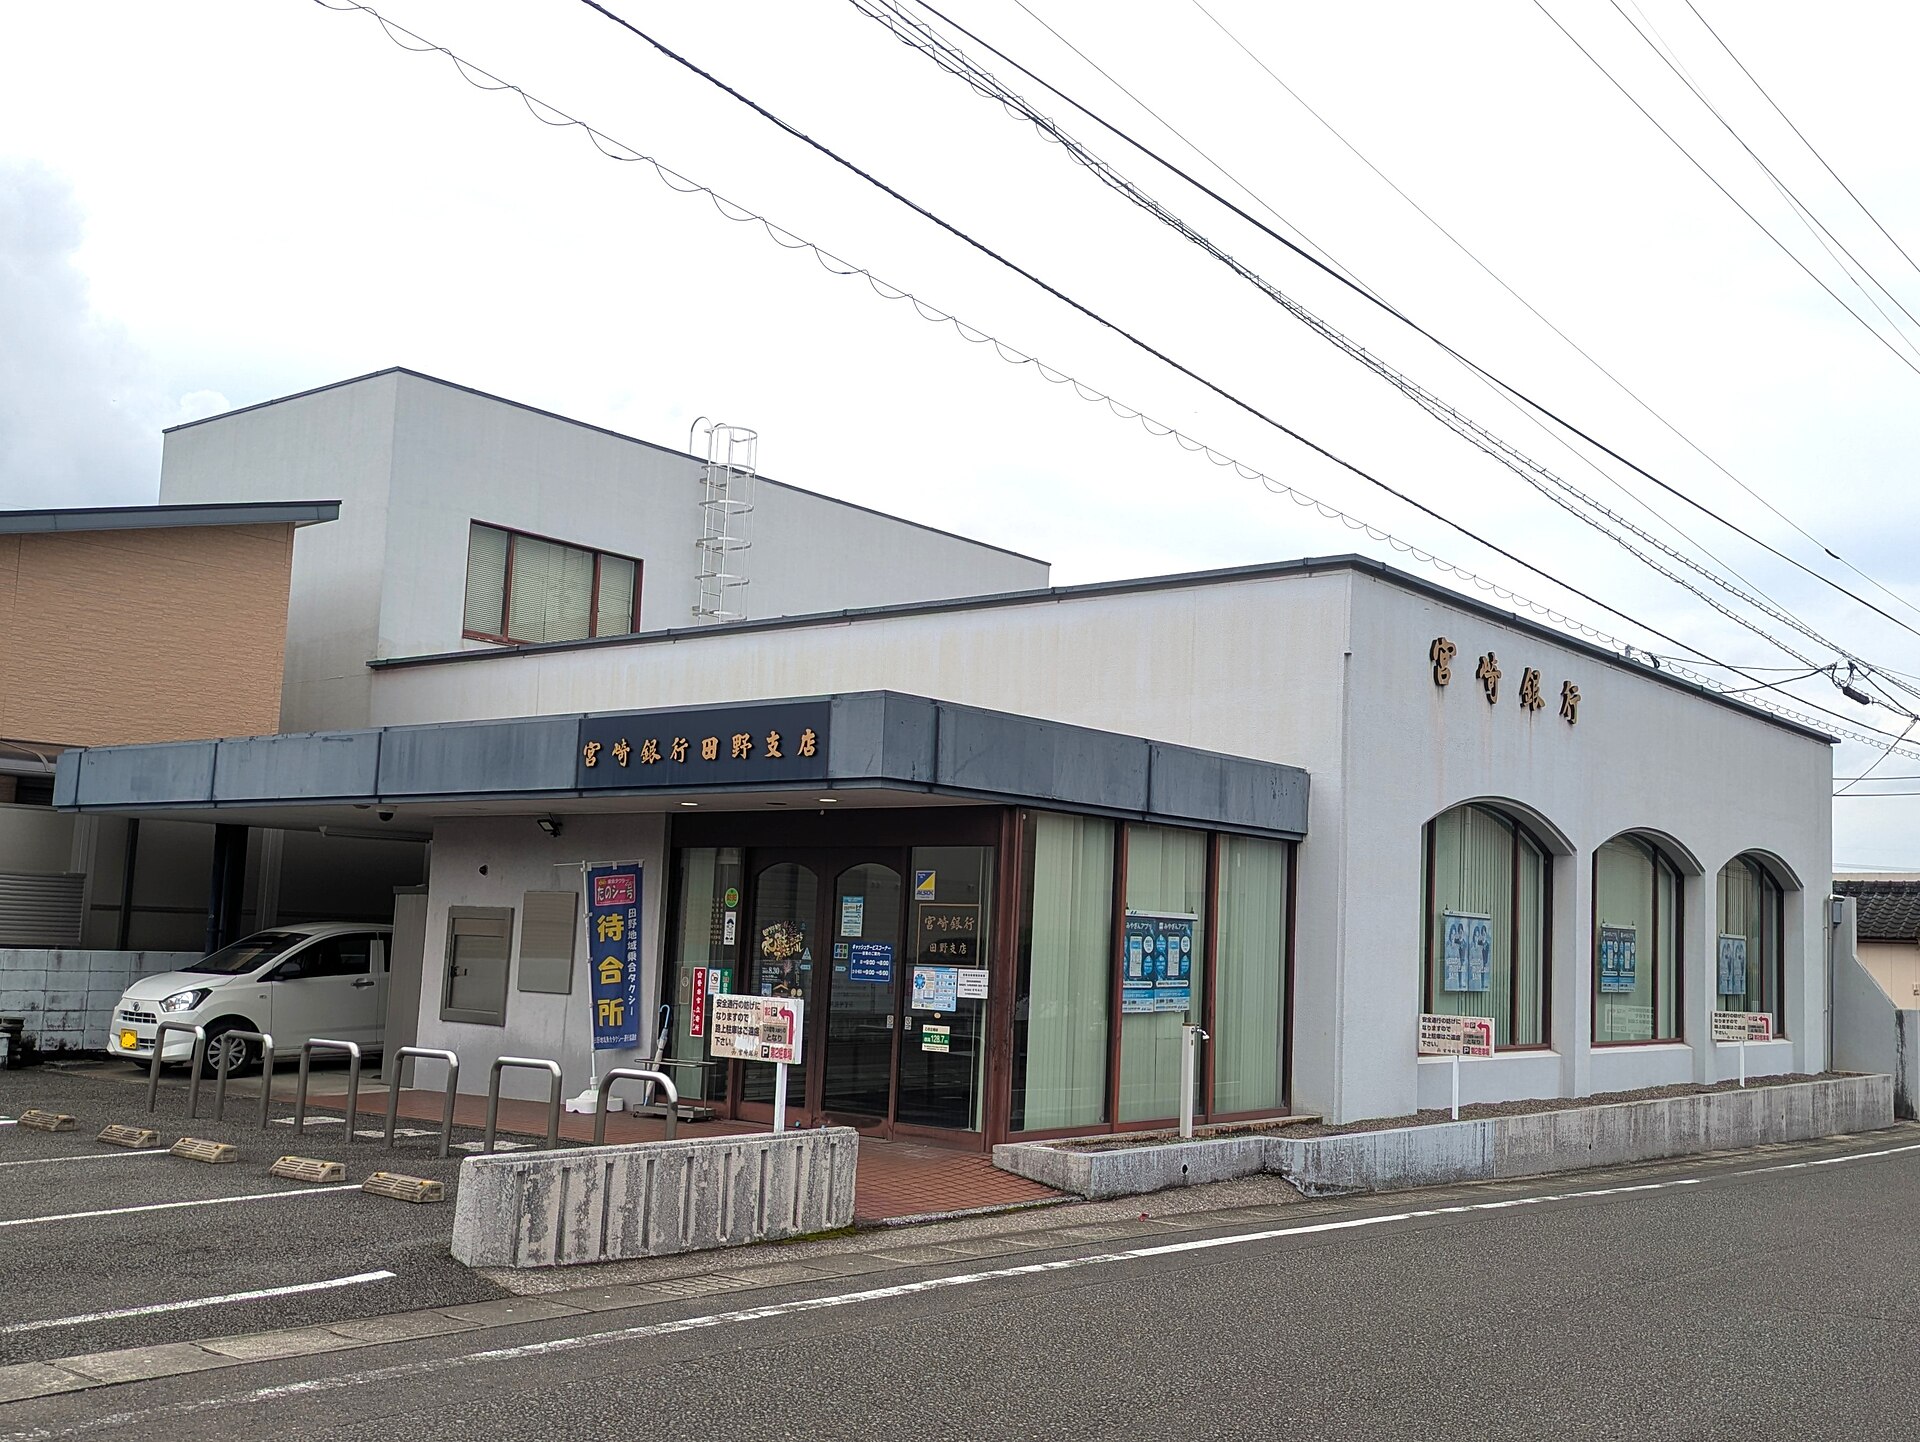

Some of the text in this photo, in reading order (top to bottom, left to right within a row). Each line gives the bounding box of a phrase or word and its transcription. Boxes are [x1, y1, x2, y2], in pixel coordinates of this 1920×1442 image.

[1430, 637, 1581, 725] 宮崎銀行
[582, 728, 818, 768] 宮崎銀行田野支店
[924, 915, 975, 932] 宮崎銀行
[929, 942, 967, 955] 田野支店
[597, 913, 625, 1027] 待合所
[627, 908, 637, 1016] 田野地域乗合タクシー
[716, 999, 761, 1010] 安全通行の妨げに
[715, 1012, 749, 1022] なりますので
[714, 1024, 760, 1036] 路上駐車はご遠慮
